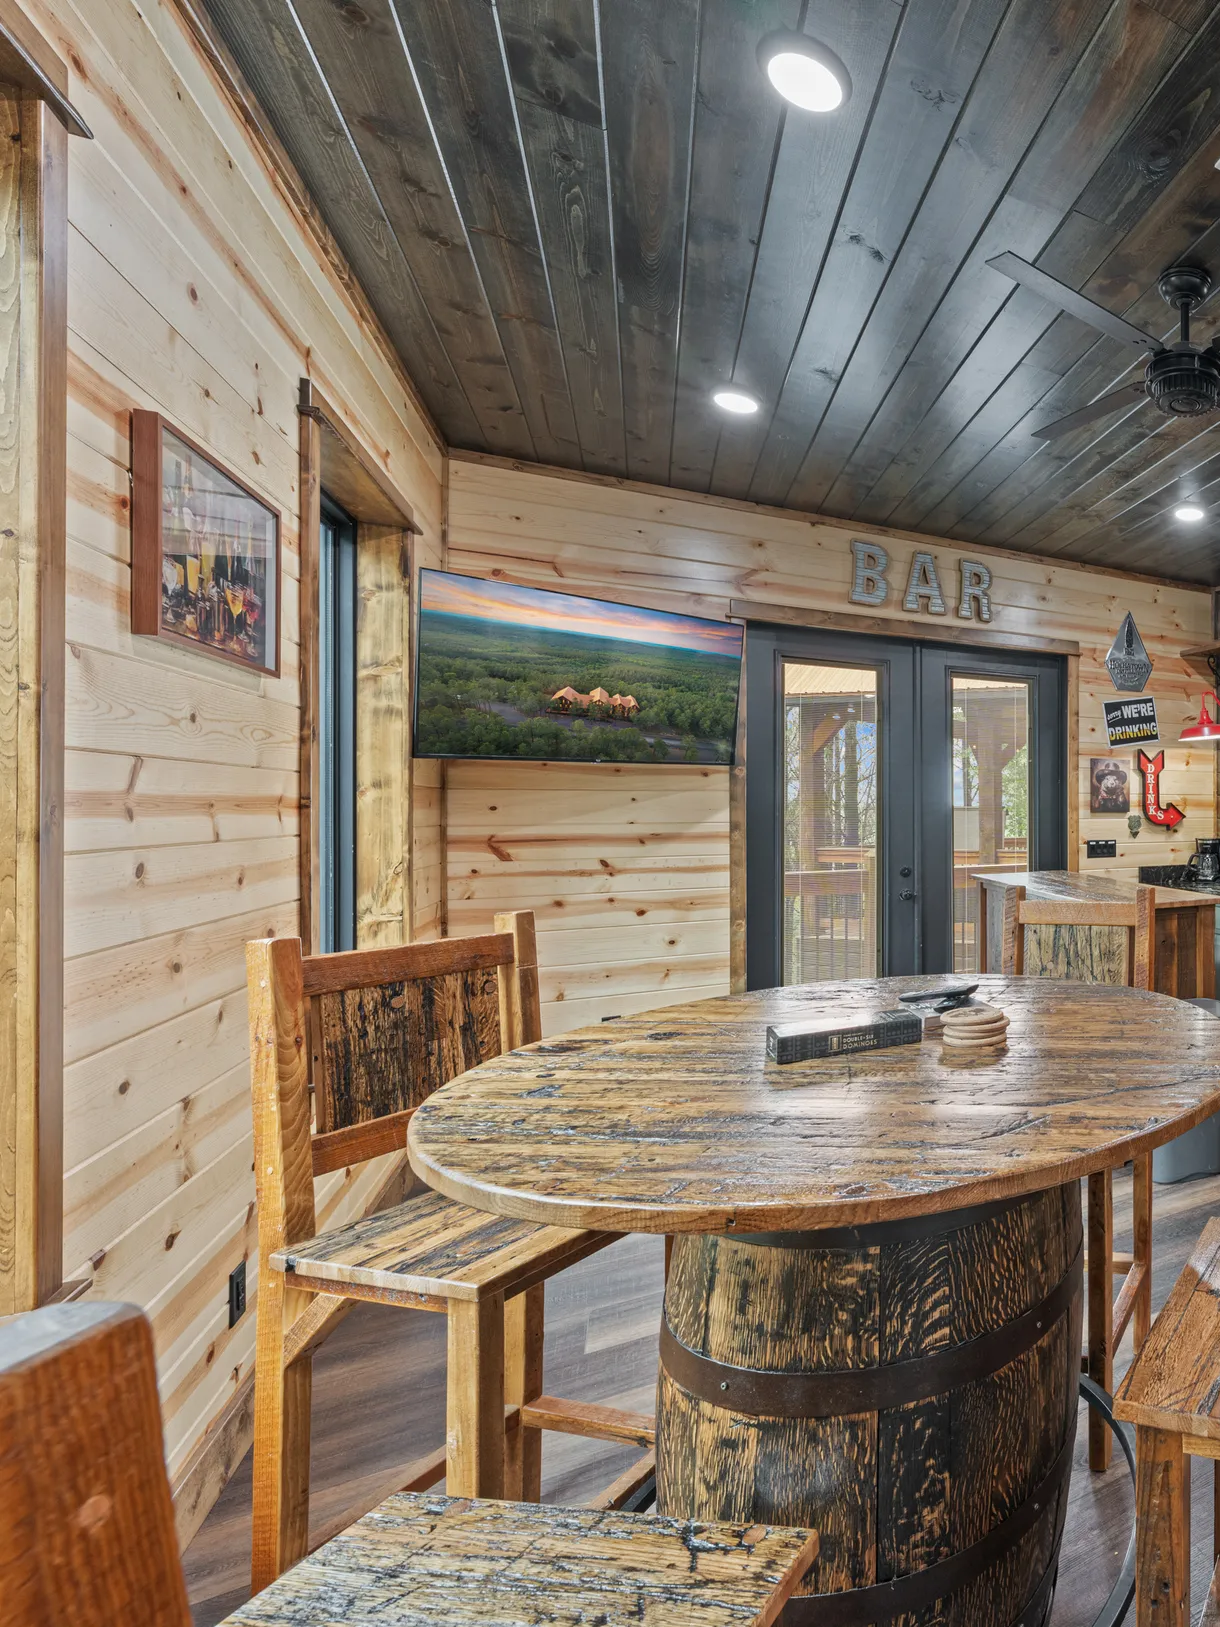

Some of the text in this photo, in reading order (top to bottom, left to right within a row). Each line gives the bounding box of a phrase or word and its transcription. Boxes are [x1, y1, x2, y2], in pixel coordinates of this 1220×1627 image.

[848, 538, 993, 623] BAR
[1121, 702, 1154, 719] WE'RE
[1108, 722, 1158, 741] DRINKING
[1147, 763, 1165, 820] DRINKS
[842, 1039, 878, 1049] DOMINOES
[843, 1034, 874, 1043] DOUBLE-SIX
